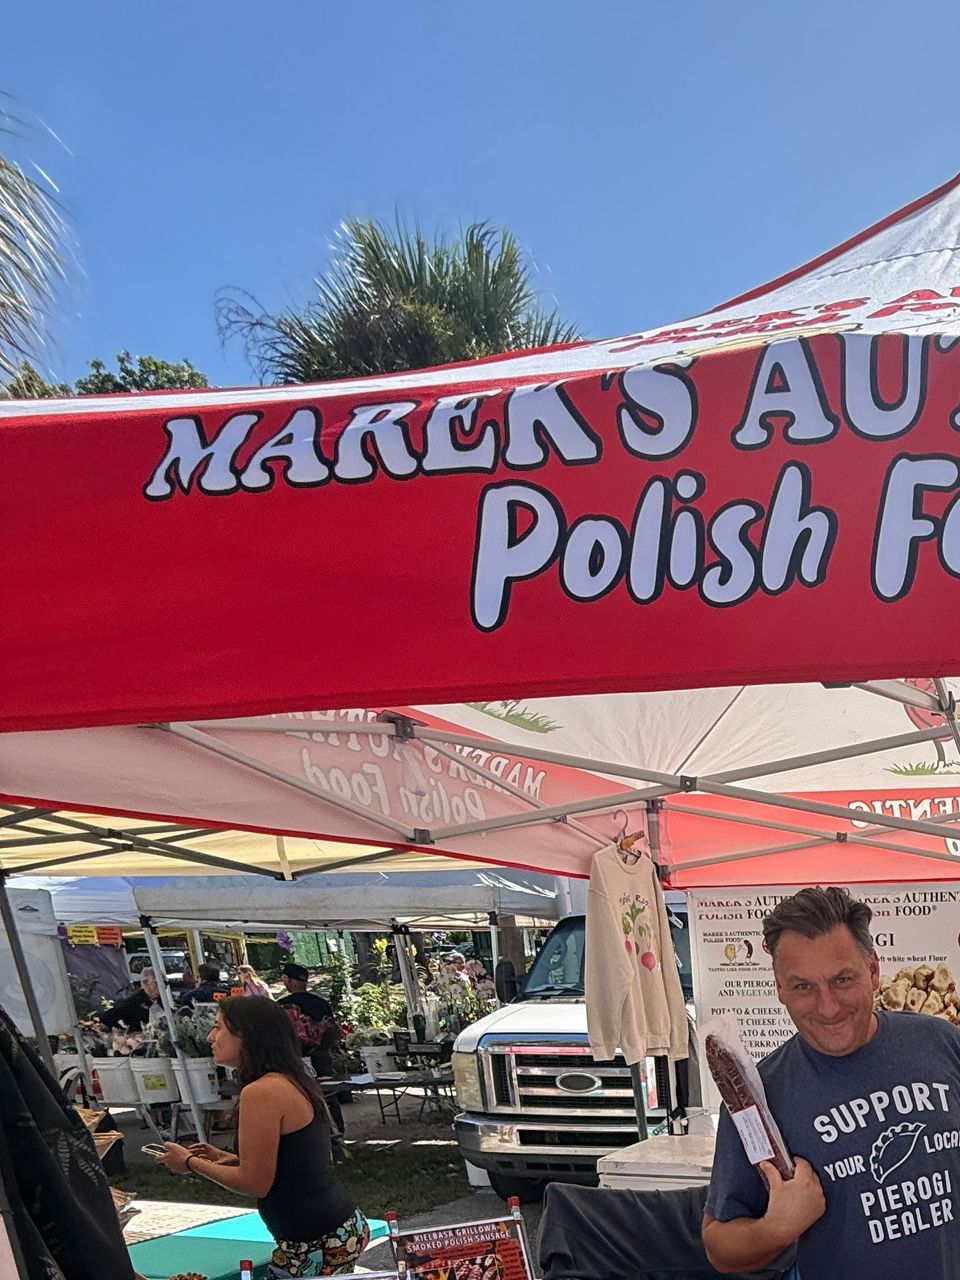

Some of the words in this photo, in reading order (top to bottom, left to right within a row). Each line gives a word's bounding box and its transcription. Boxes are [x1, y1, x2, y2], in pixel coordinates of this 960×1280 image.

[143, 356, 701, 501] MAREK'S
[471, 461, 837, 632] Polish
[718, 989, 735, 998] AND
[724, 980, 743, 989] OUR
[746, 1018, 777, 1026] CHEESE
[752, 1007, 783, 1016] CHEESE
[813, 1081, 951, 1145] SUPPORT
[823, 1154, 868, 1183] YOUR
[859, 1168, 953, 1218] PIEROGI
[413, 1228, 455, 1244] KIELBASA
[455, 1223, 498, 1238] GRILLOWA
[867, 1197, 955, 1245] DEALER
[406, 1239, 443, 1255] SMOKED
[444, 1235, 474, 1249] POLISH
[474, 1229, 512, 1244] SAUSAGE
